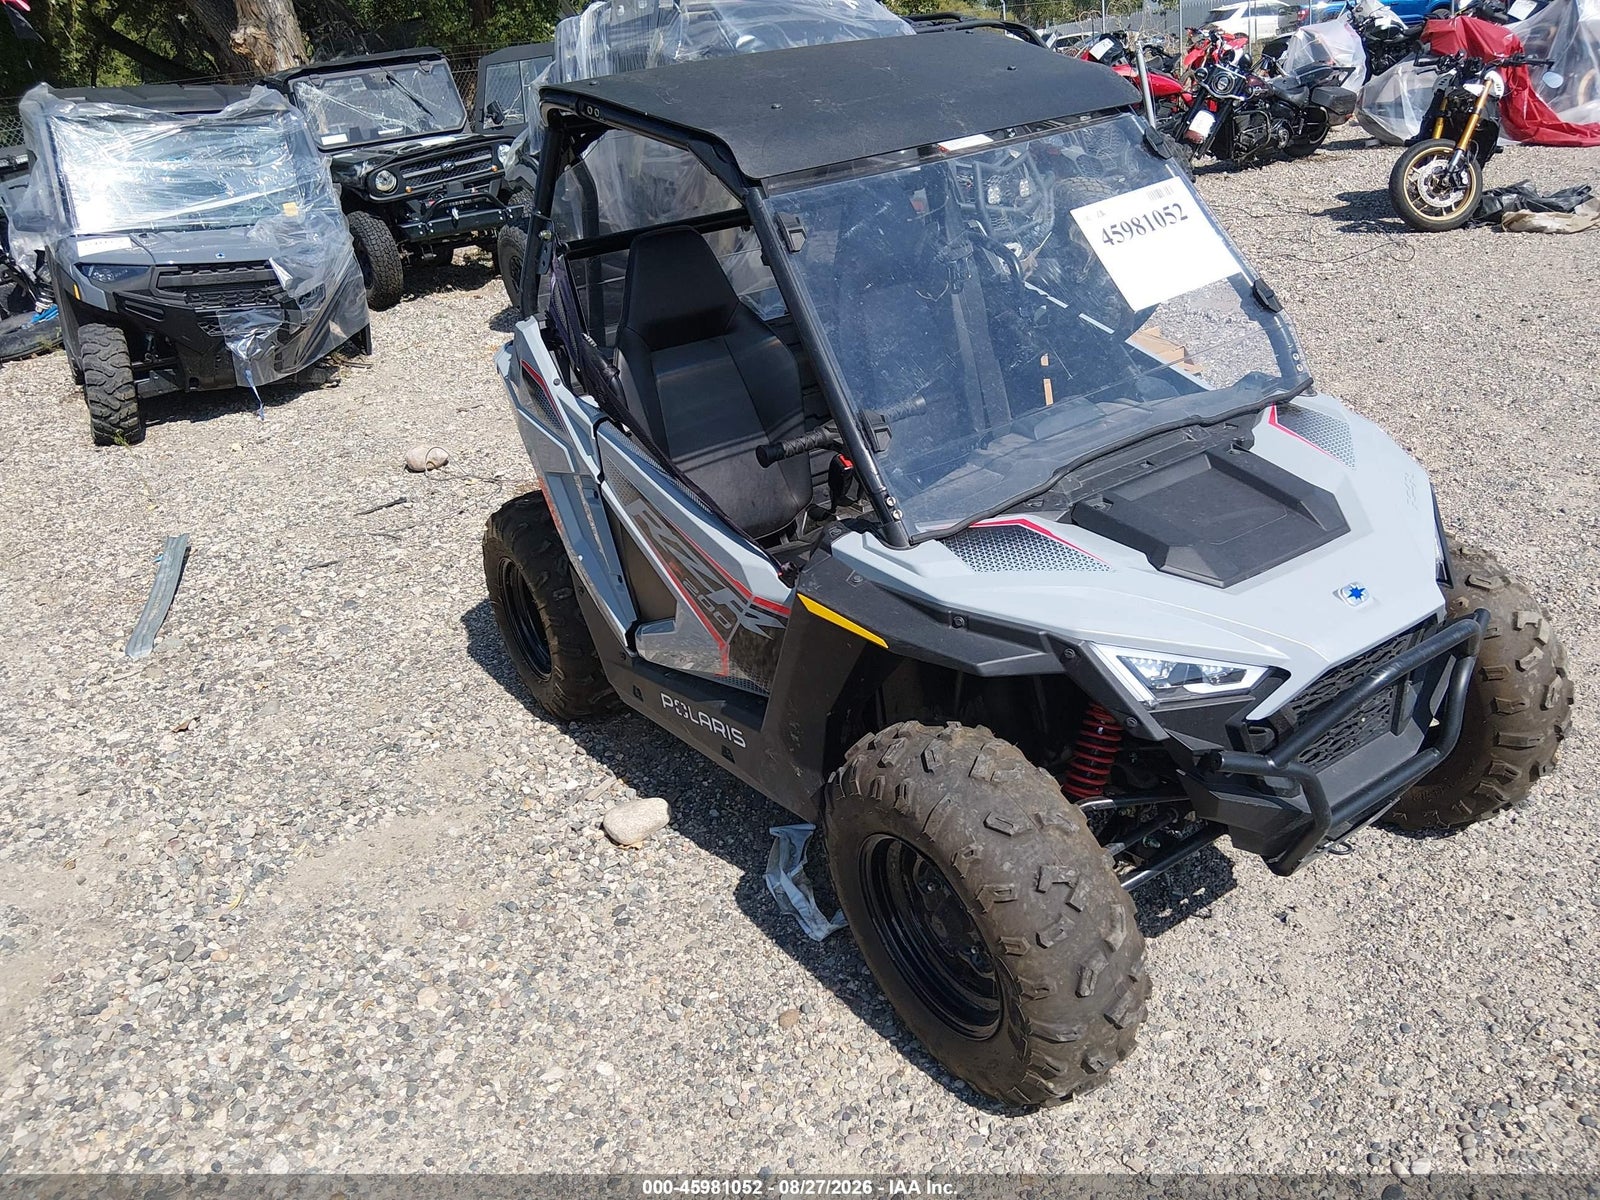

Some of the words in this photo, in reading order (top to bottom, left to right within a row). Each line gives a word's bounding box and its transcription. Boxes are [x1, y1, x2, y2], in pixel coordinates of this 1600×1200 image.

[1101, 203, 1189, 246] 45981052
[624, 498, 787, 641] RZR
[682, 577, 732, 630] 200
[660, 692, 746, 748] POLARIS
